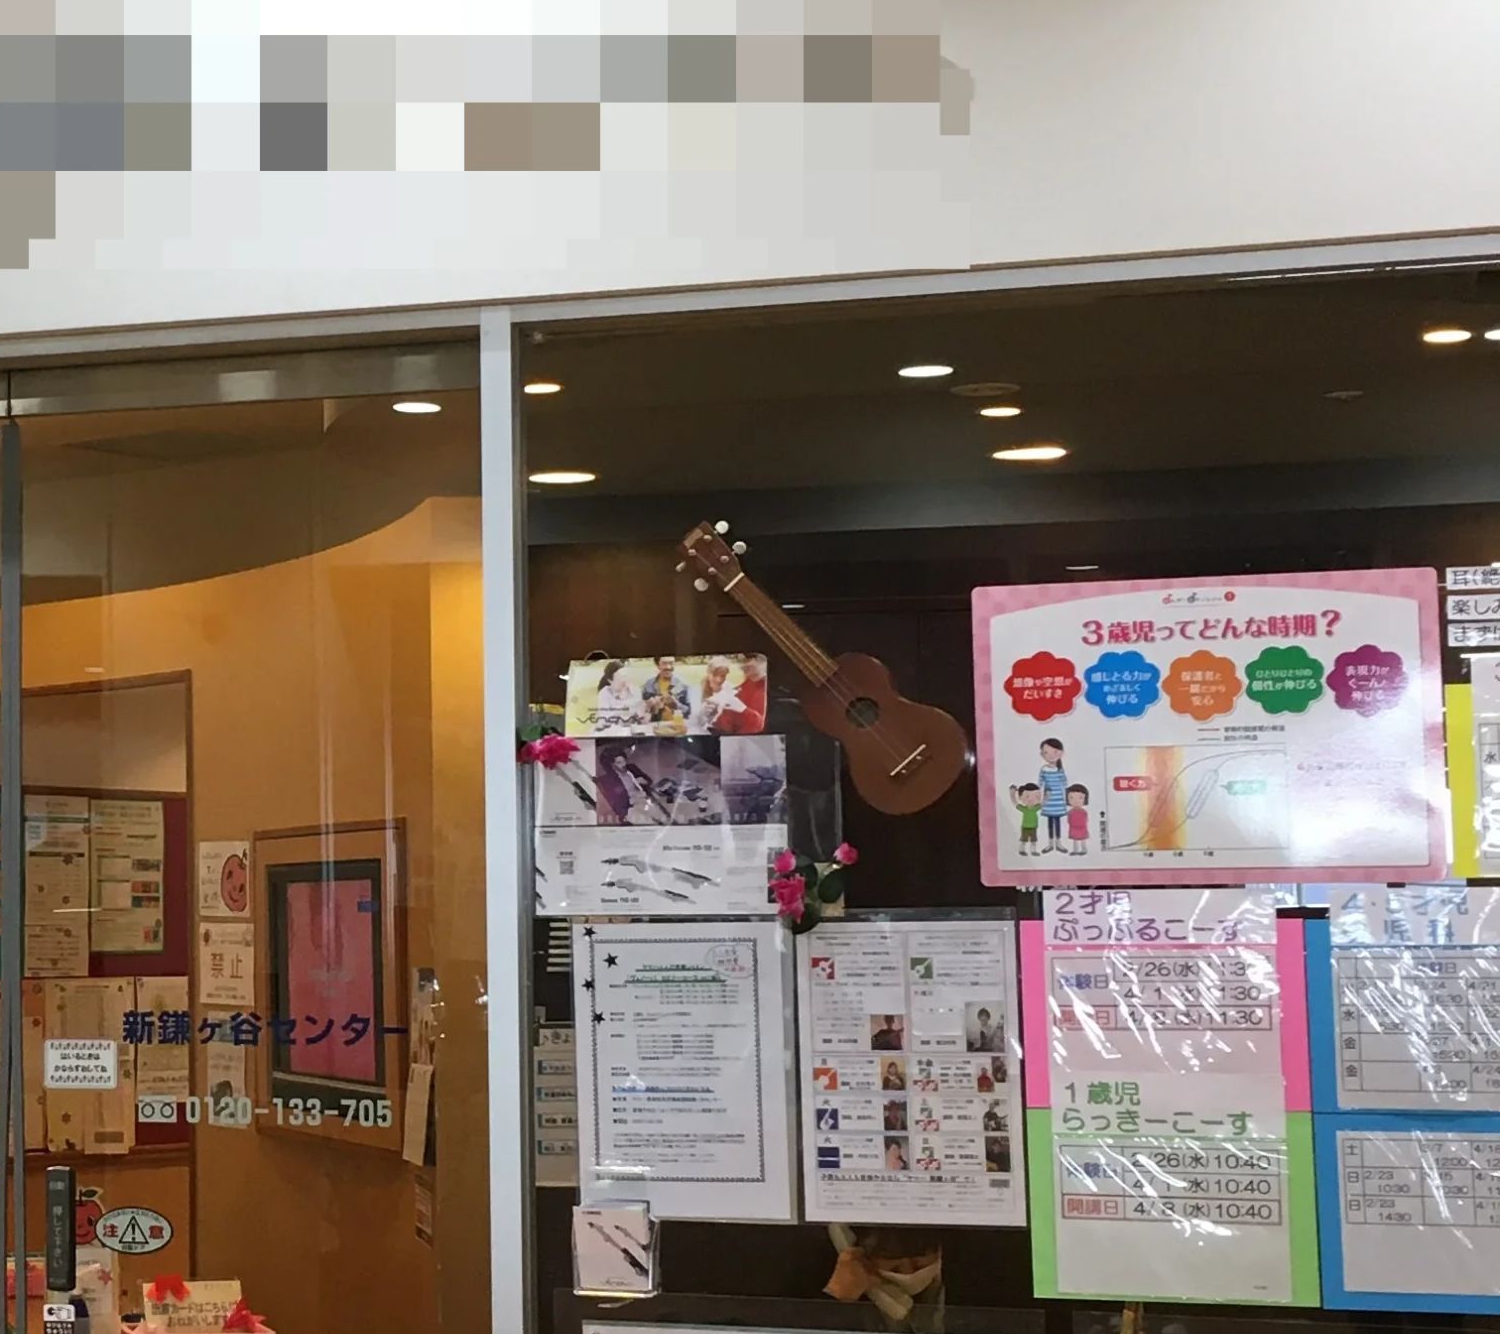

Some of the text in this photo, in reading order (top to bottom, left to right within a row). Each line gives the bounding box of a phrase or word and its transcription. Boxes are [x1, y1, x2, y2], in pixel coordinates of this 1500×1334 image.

[1081, 610, 1342, 646] 3歳児ってどんな時期?
[1023, 689, 1063, 700] だいすき
[1106, 694, 1139, 704] 伸びる
[122, 1009, 409, 1046] 新鎌ヶ谷センター
[1064, 1081, 1141, 1106] 1歳児
[185, 1097, 393, 1130] 0120-133-705
[1062, 1110, 1253, 1134] らっきーこーす
